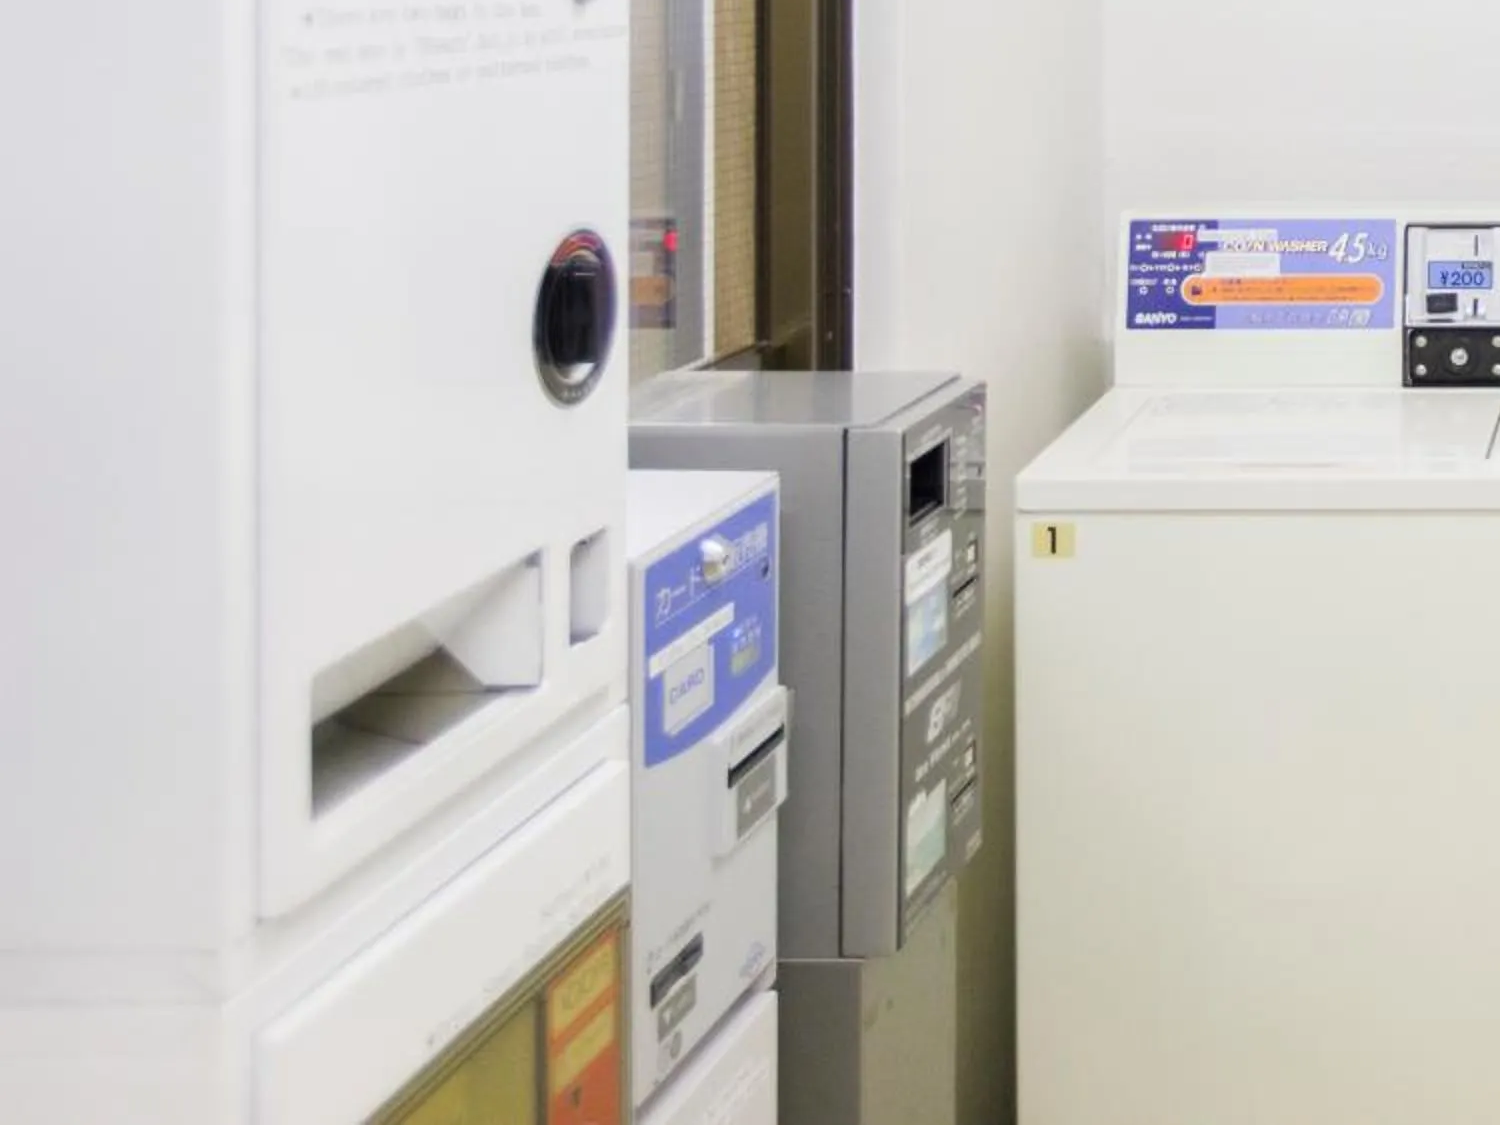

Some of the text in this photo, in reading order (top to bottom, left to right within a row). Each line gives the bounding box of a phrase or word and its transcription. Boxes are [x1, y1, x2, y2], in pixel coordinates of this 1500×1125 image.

[1270, 239, 1328, 253] WASHER
[1440, 269, 1485, 286] ¥200
[1134, 311, 1177, 326] SANYO
[1047, 526, 1057, 555] 1
